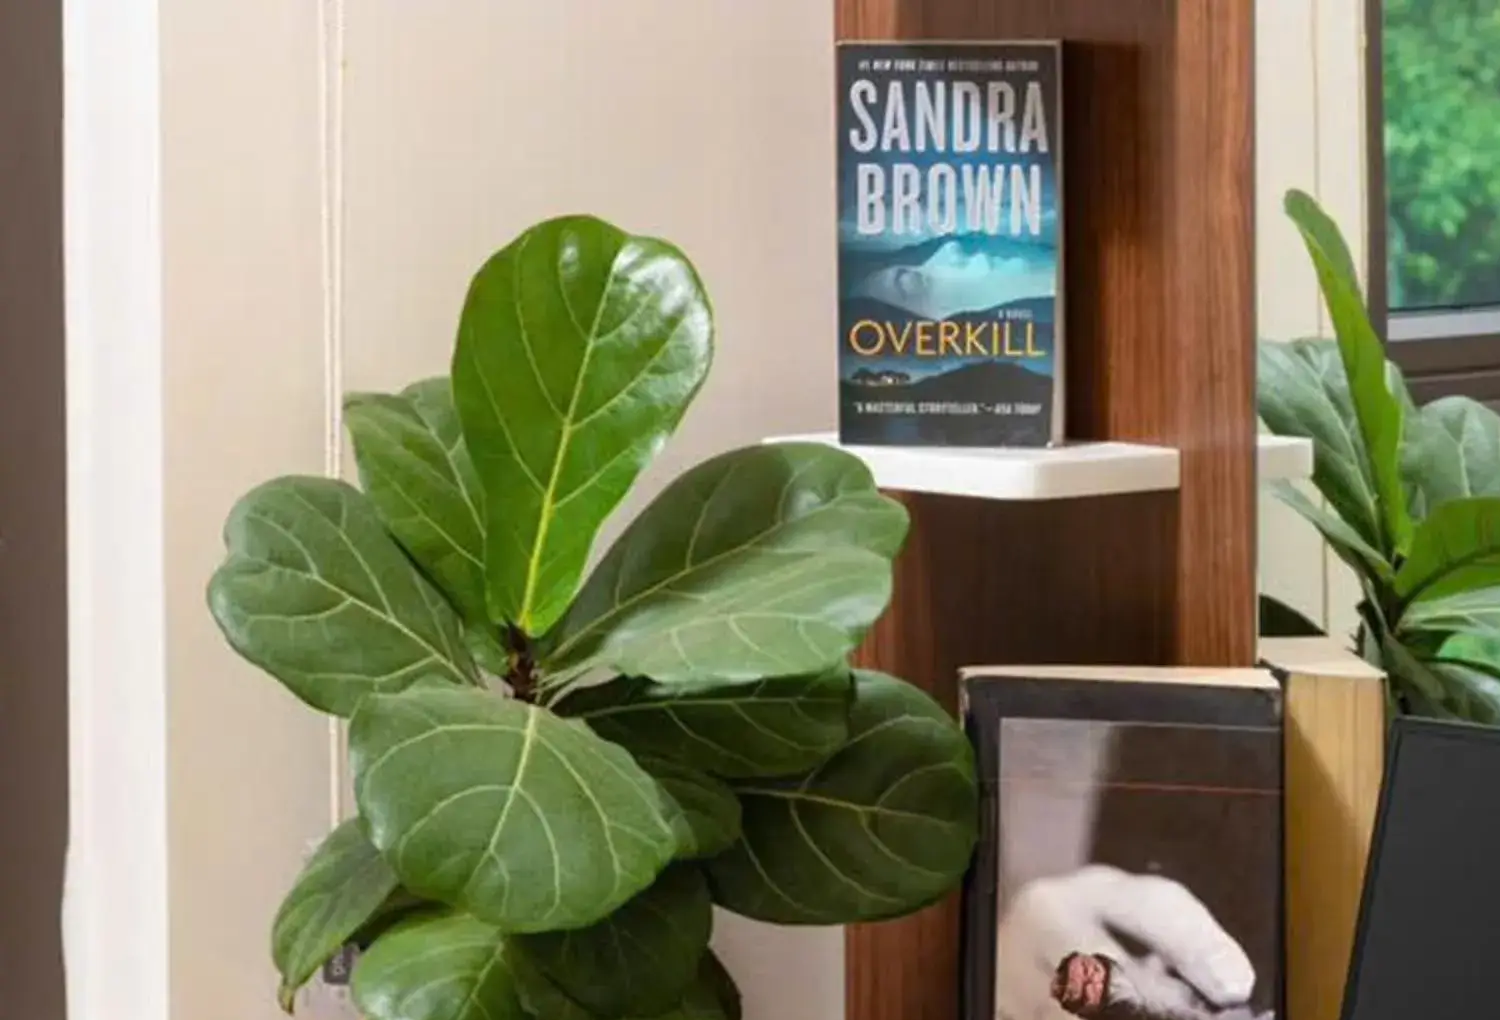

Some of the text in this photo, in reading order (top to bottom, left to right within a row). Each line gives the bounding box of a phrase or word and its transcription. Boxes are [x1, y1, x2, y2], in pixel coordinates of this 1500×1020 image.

[849, 79, 1049, 153] SANDRA
[857, 162, 1041, 236] BROWN
[849, 319, 1047, 357] OVERKILL
